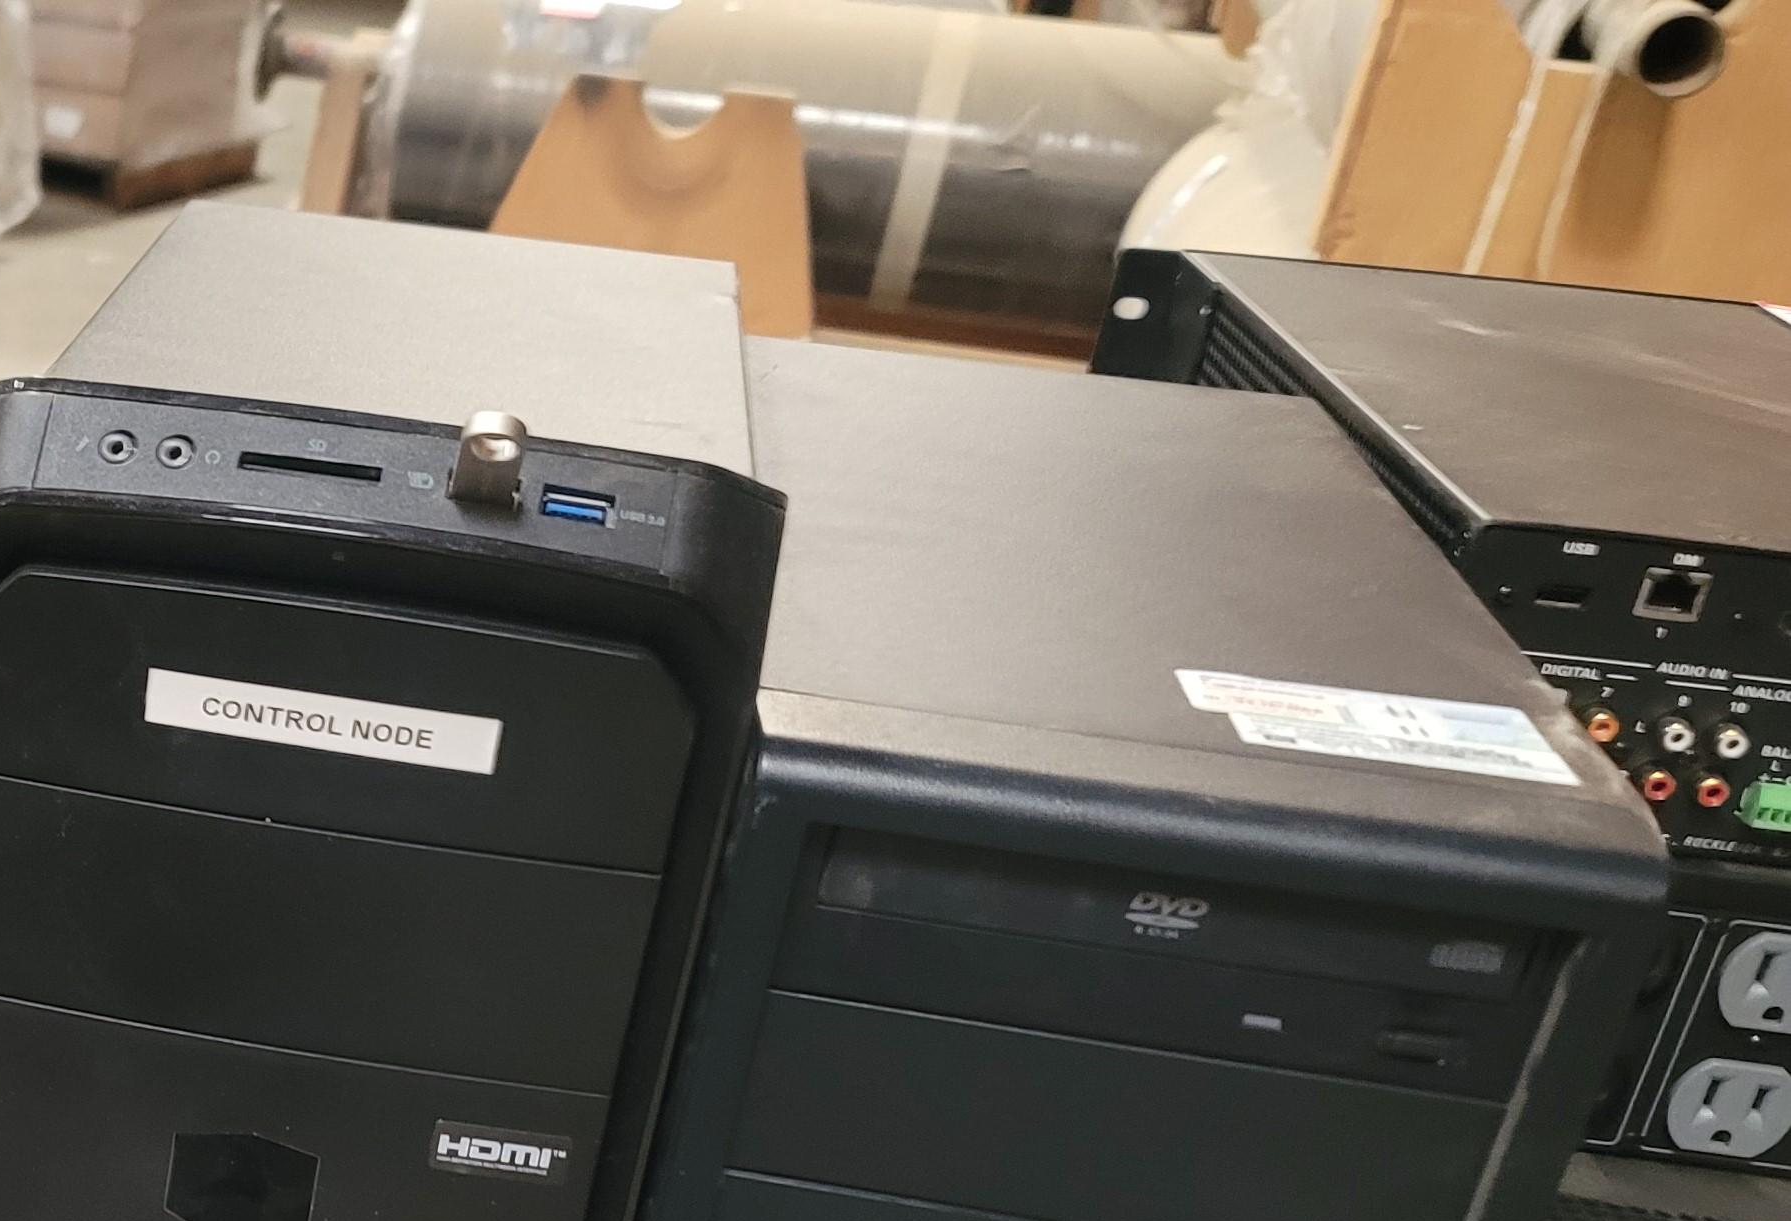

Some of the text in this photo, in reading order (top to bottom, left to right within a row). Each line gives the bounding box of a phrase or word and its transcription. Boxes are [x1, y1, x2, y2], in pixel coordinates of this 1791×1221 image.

[1563, 541, 1600, 556] USB
[1541, 663, 1602, 680] DIGITAL
[1657, 661, 1730, 681] AUDIO IN
[201, 695, 435, 750] CONTROL NODE
[1129, 891, 1209, 918] DVD
[437, 1133, 552, 1170] HDMI
